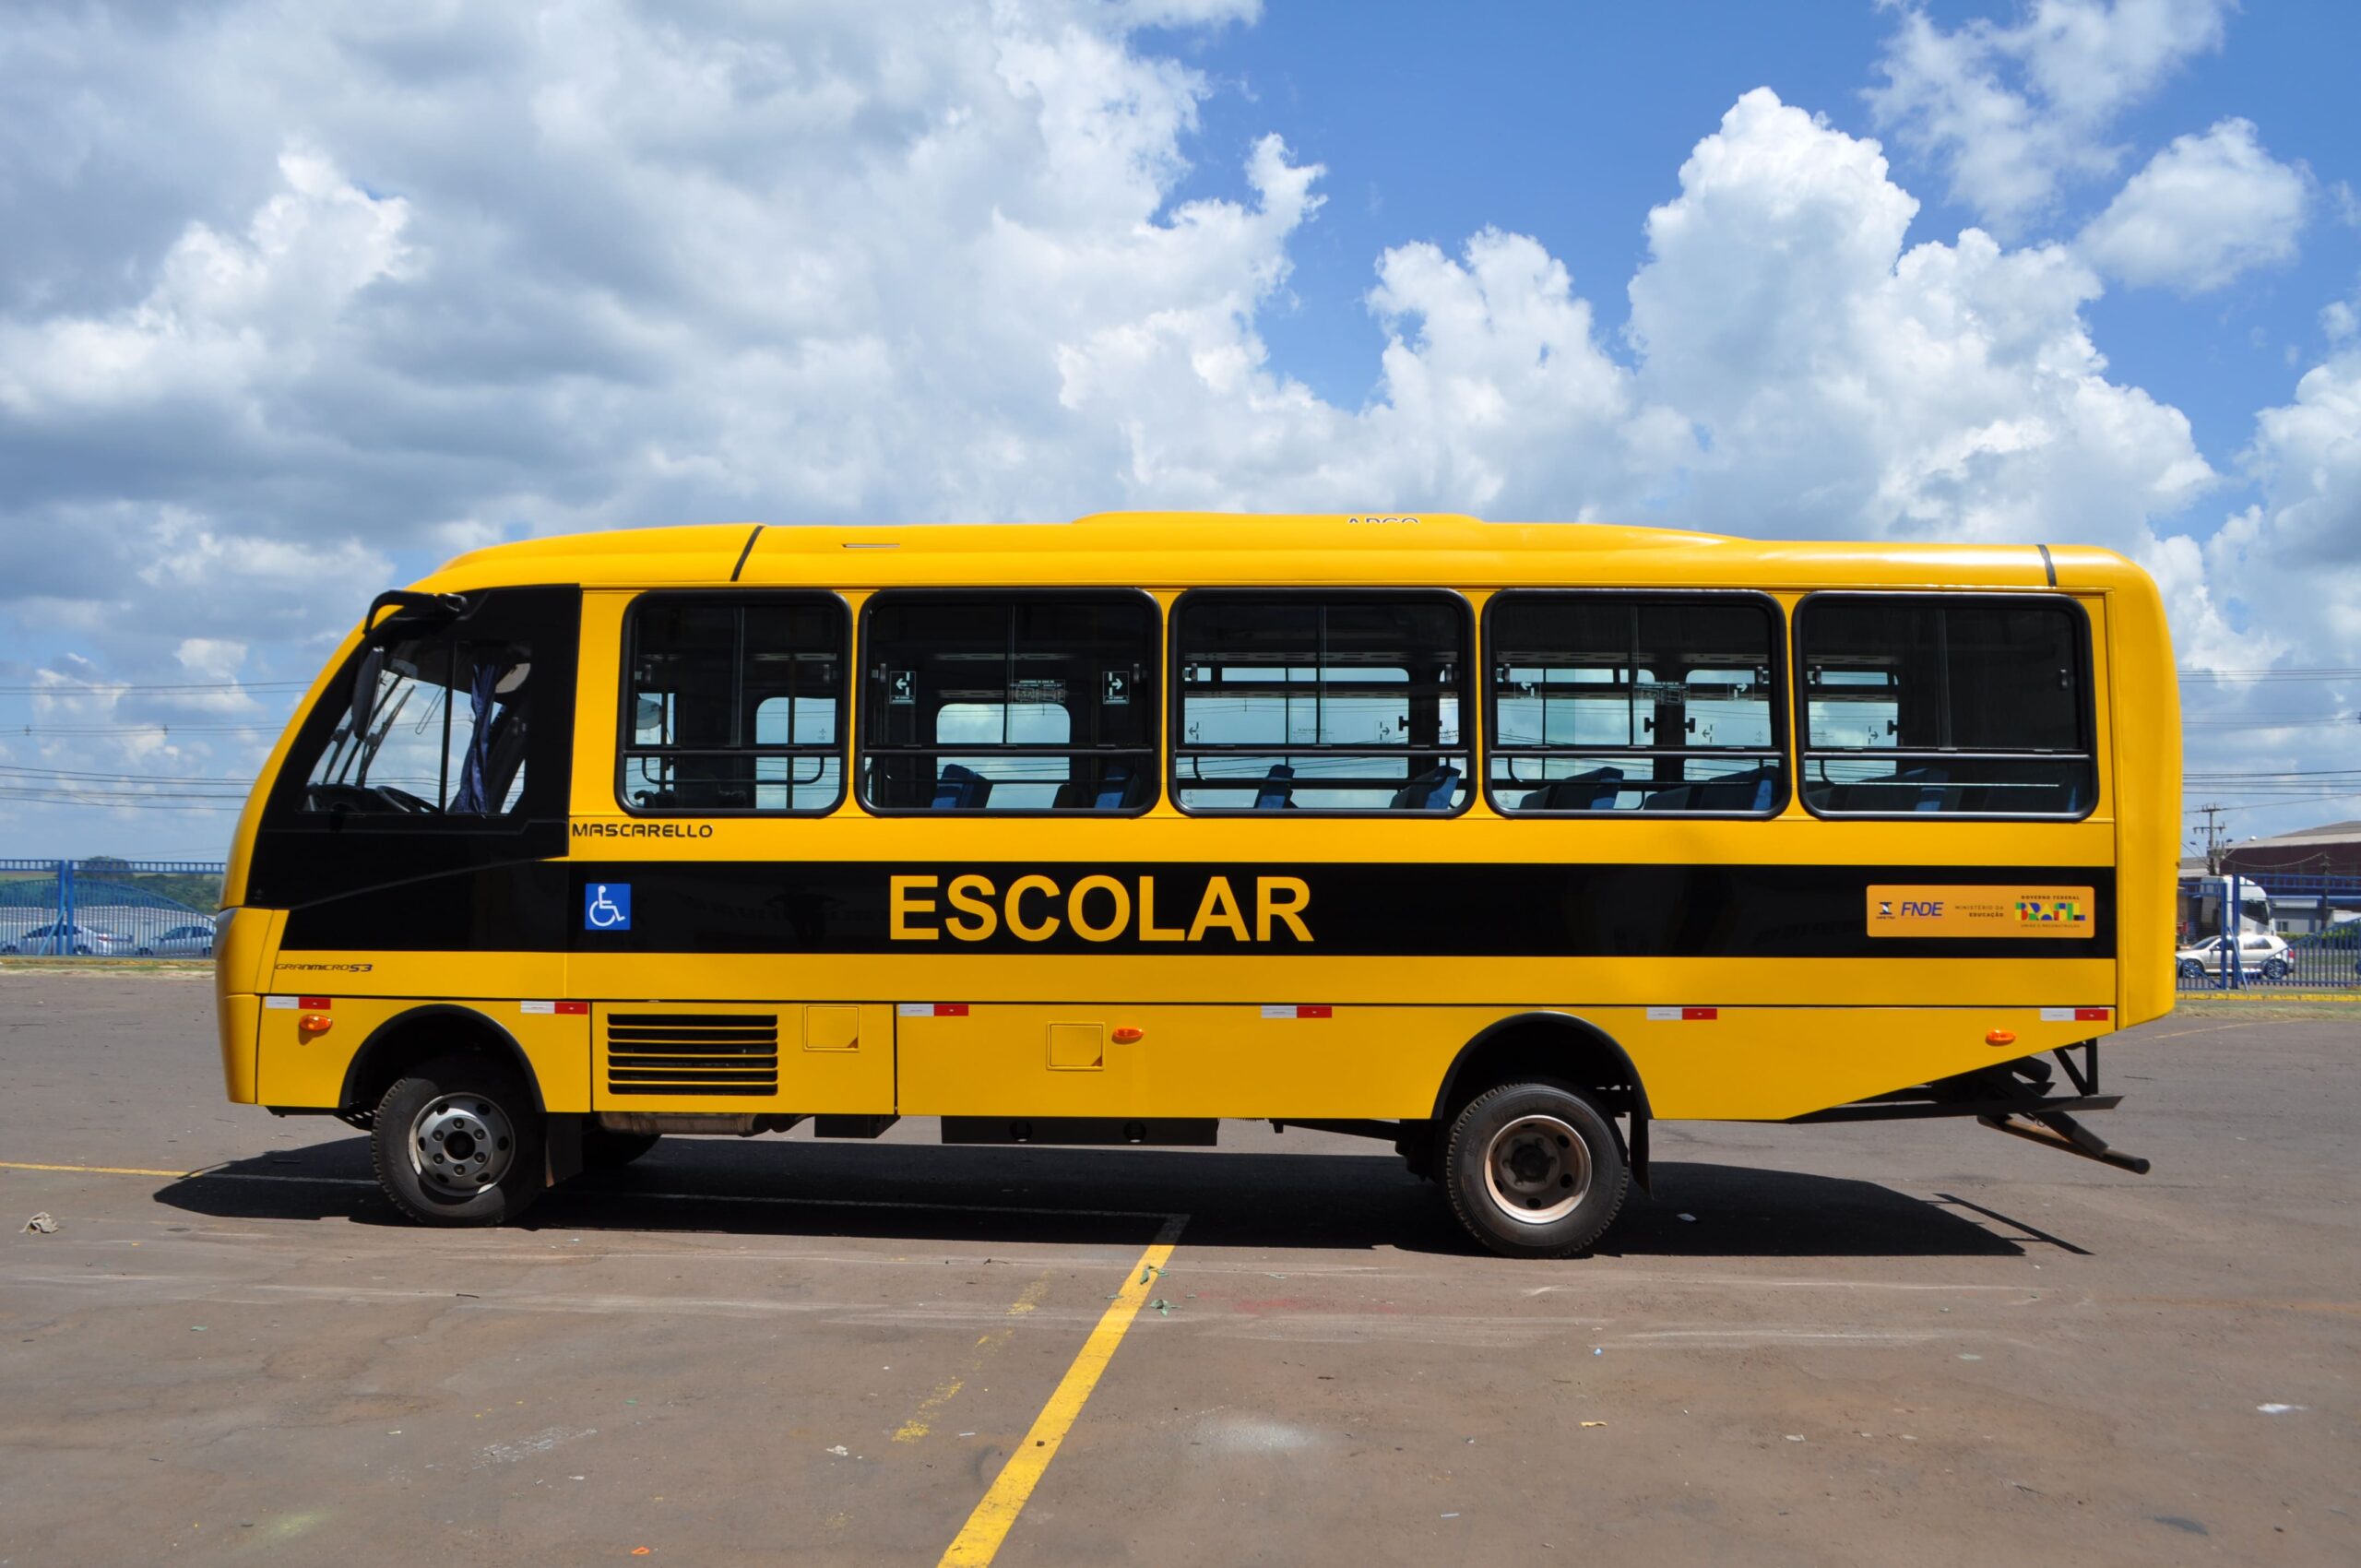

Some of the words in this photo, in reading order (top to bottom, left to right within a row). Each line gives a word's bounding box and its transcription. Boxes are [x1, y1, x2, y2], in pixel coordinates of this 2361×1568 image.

[572, 823, 714, 838] MASCARELLO
[890, 873, 1315, 943] ESCOLAR
[1900, 901, 1944, 917] FNDE
[2014, 901, 2086, 921] BRASIL
